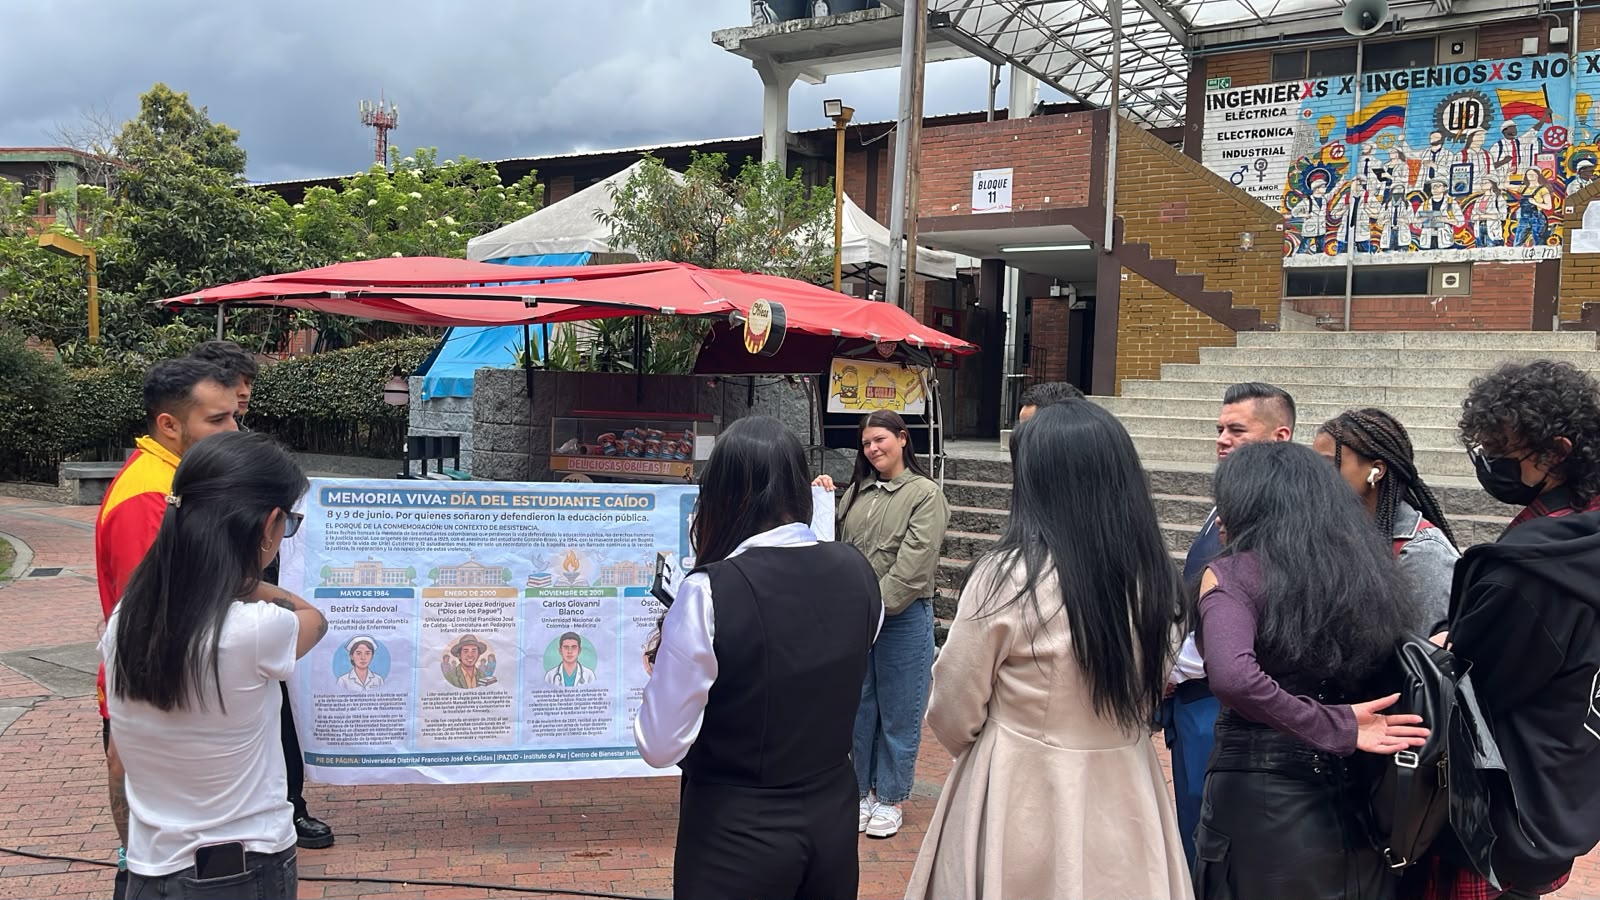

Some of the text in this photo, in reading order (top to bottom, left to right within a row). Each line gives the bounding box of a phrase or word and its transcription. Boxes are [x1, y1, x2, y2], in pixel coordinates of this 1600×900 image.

[1207, 80, 1328, 110] INGENIERXS
[1337, 76, 1354, 95] X
[1367, 62, 1522, 93] INGENIOSXS
[1531, 58, 1568, 80] NO
[1226, 107, 1287, 121] ELÉCTRICA
[1218, 128, 1294, 141] ELECTRONICA
[1222, 146, 1285, 159] INDUSTRIAL
[978, 179, 1008, 190] BLOQUE
[988, 191, 996, 203] 11
[568, 459, 623, 471] DELICIOSAS
[624, 462, 660, 472] OBLEAS
[328, 492, 649, 508] MEMORIA VIVA: DÍA DEL ESTUDIANTE CAÍDO
[366, 511, 393, 520] junio.
[414, 512, 451, 521] quienes
[453, 512, 490, 520] soñaron
[501, 512, 555, 520] defendieron
[568, 513, 613, 521] educación
[616, 514, 649, 522] pública.
